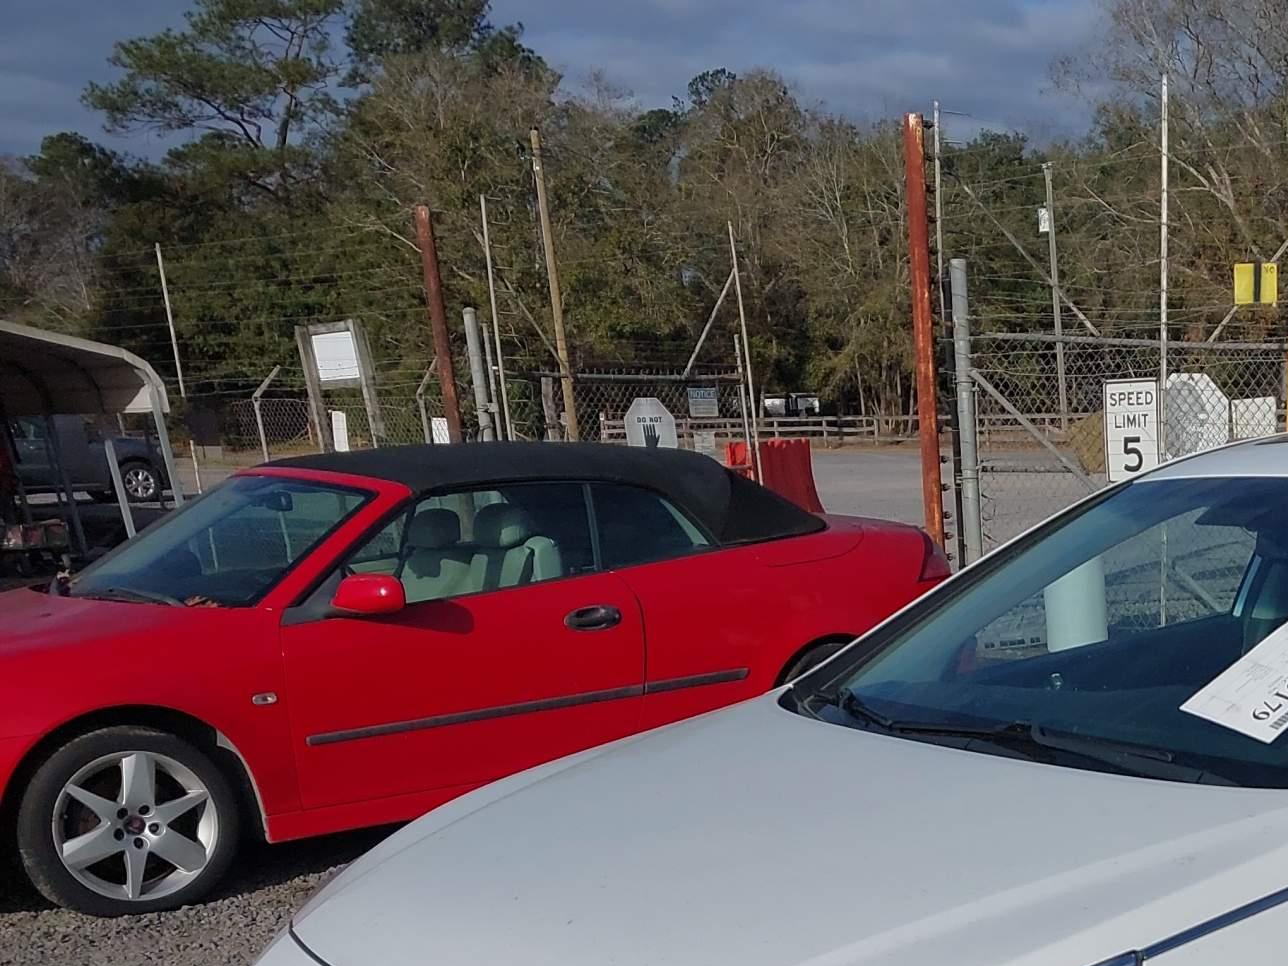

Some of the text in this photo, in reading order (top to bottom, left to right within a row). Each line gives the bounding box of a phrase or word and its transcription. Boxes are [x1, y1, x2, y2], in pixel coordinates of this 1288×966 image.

[691, 390, 716, 398] NOTICE
[1109, 391, 1154, 407] SPEED
[1114, 413, 1149, 429] LIMIT
[1123, 436, 1144, 473] 5
